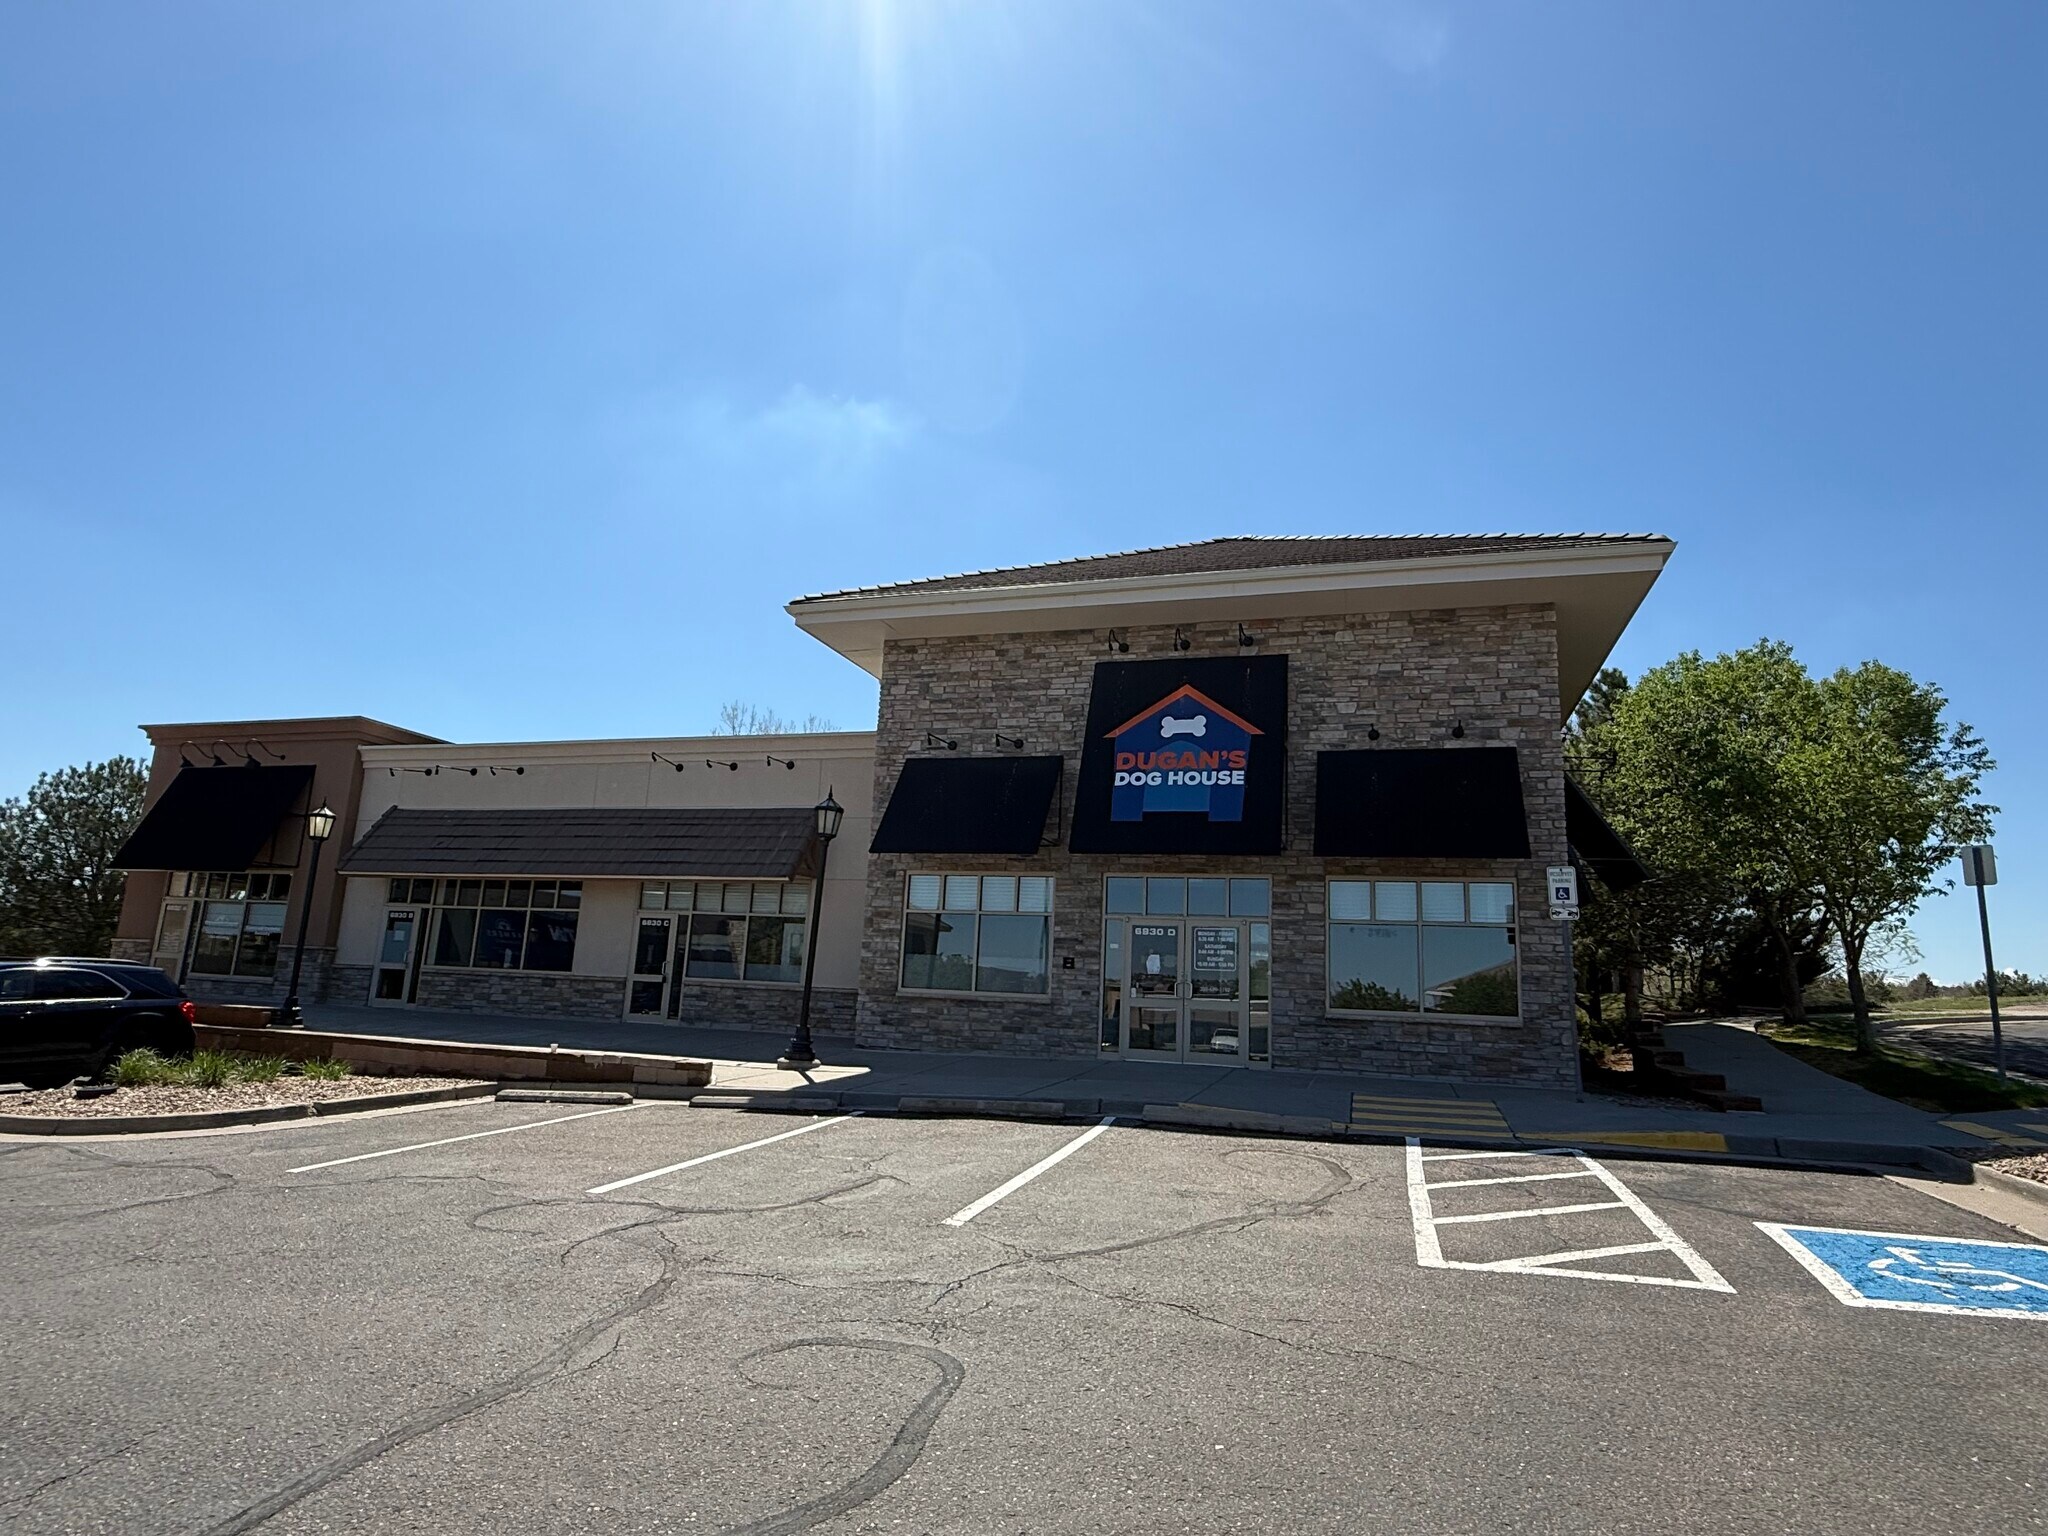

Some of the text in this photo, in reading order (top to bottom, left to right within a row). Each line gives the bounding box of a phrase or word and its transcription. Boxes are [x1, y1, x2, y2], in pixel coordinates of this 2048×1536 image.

[1116, 750, 1246, 770] DUGAN'S
[1114, 770, 1245, 787] DOG HOUSE
[1167, 928, 1176, 936] D
